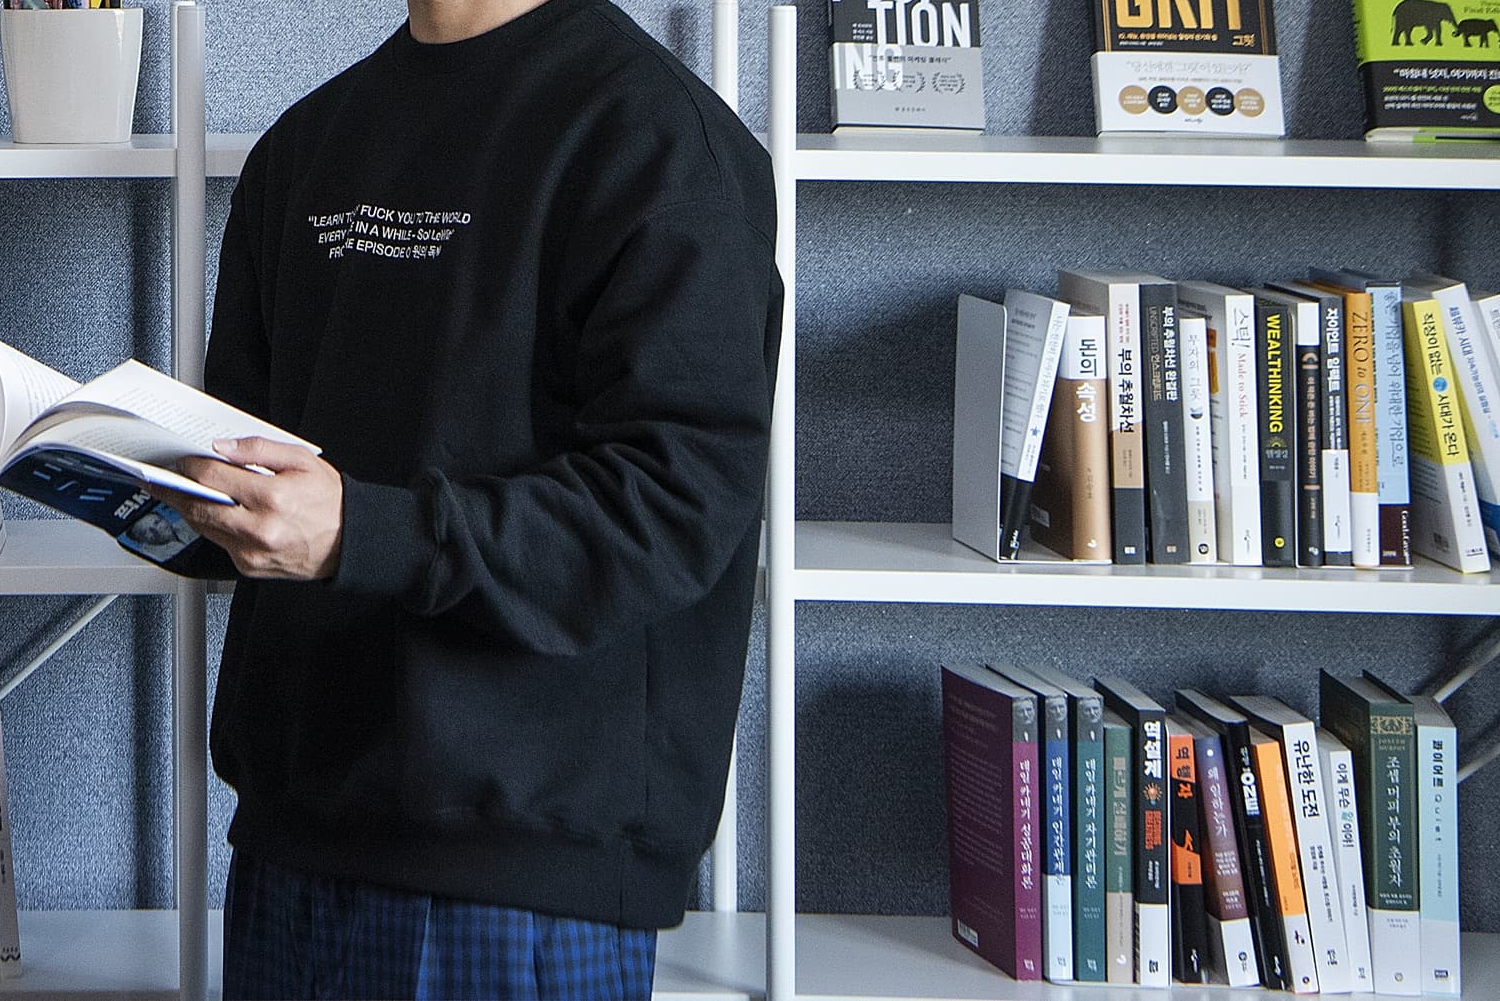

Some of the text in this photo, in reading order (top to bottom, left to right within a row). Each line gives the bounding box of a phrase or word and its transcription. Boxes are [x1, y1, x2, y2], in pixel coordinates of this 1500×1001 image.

[318, 229, 347, 244] EVERY
[355, 220, 369, 234] IN
[369, 225, 379, 237] A
[382, 225, 411, 241] WHILE
[360, 205, 395, 222] FUCK
[397, 211, 415, 225] YOU
[425, 211, 441, 224] THE
[356, 239, 405, 258] EPISODE
[1148, 306, 1160, 351] UNSCRIPTED
[1229, 307, 1250, 348] 스틱!
[1325, 308, 1340, 392] 자이언트 임팩트
[1351, 311, 1369, 362] ZERO
[1385, 318, 1400, 351] 기업을
[1118, 348, 1133, 375] 부의
[1162, 306, 1178, 402] 부의 추월차선 완결판
[1266, 314, 1282, 432] WEALTHINKING
[1356, 366, 1366, 377] to
[1386, 354, 1401, 377] 넘어
[1076, 338, 1098, 423] 돈의 속성
[1235, 352, 1248, 417] Made to Stick
[1387, 381, 1402, 415] 위대한
[1420, 312, 1459, 456] 직장이 없는 시대가 온다
[1118, 379, 1135, 433] 추월차선
[1389, 419, 1404, 467] 기업으로
[1175, 746, 1193, 799] 역행자
[1207, 766, 1219, 780] 왜
[1293, 740, 1320, 819] 유난한 도전
[1335, 762, 1348, 784] 이게
[1433, 740, 1444, 787] 콰이어트
[1113, 756, 1127, 856] 빠르게 실패하기
[1210, 783, 1228, 838] 일하는가
[1337, 787, 1350, 808] 무슨
[1387, 785, 1400, 814] 머피
